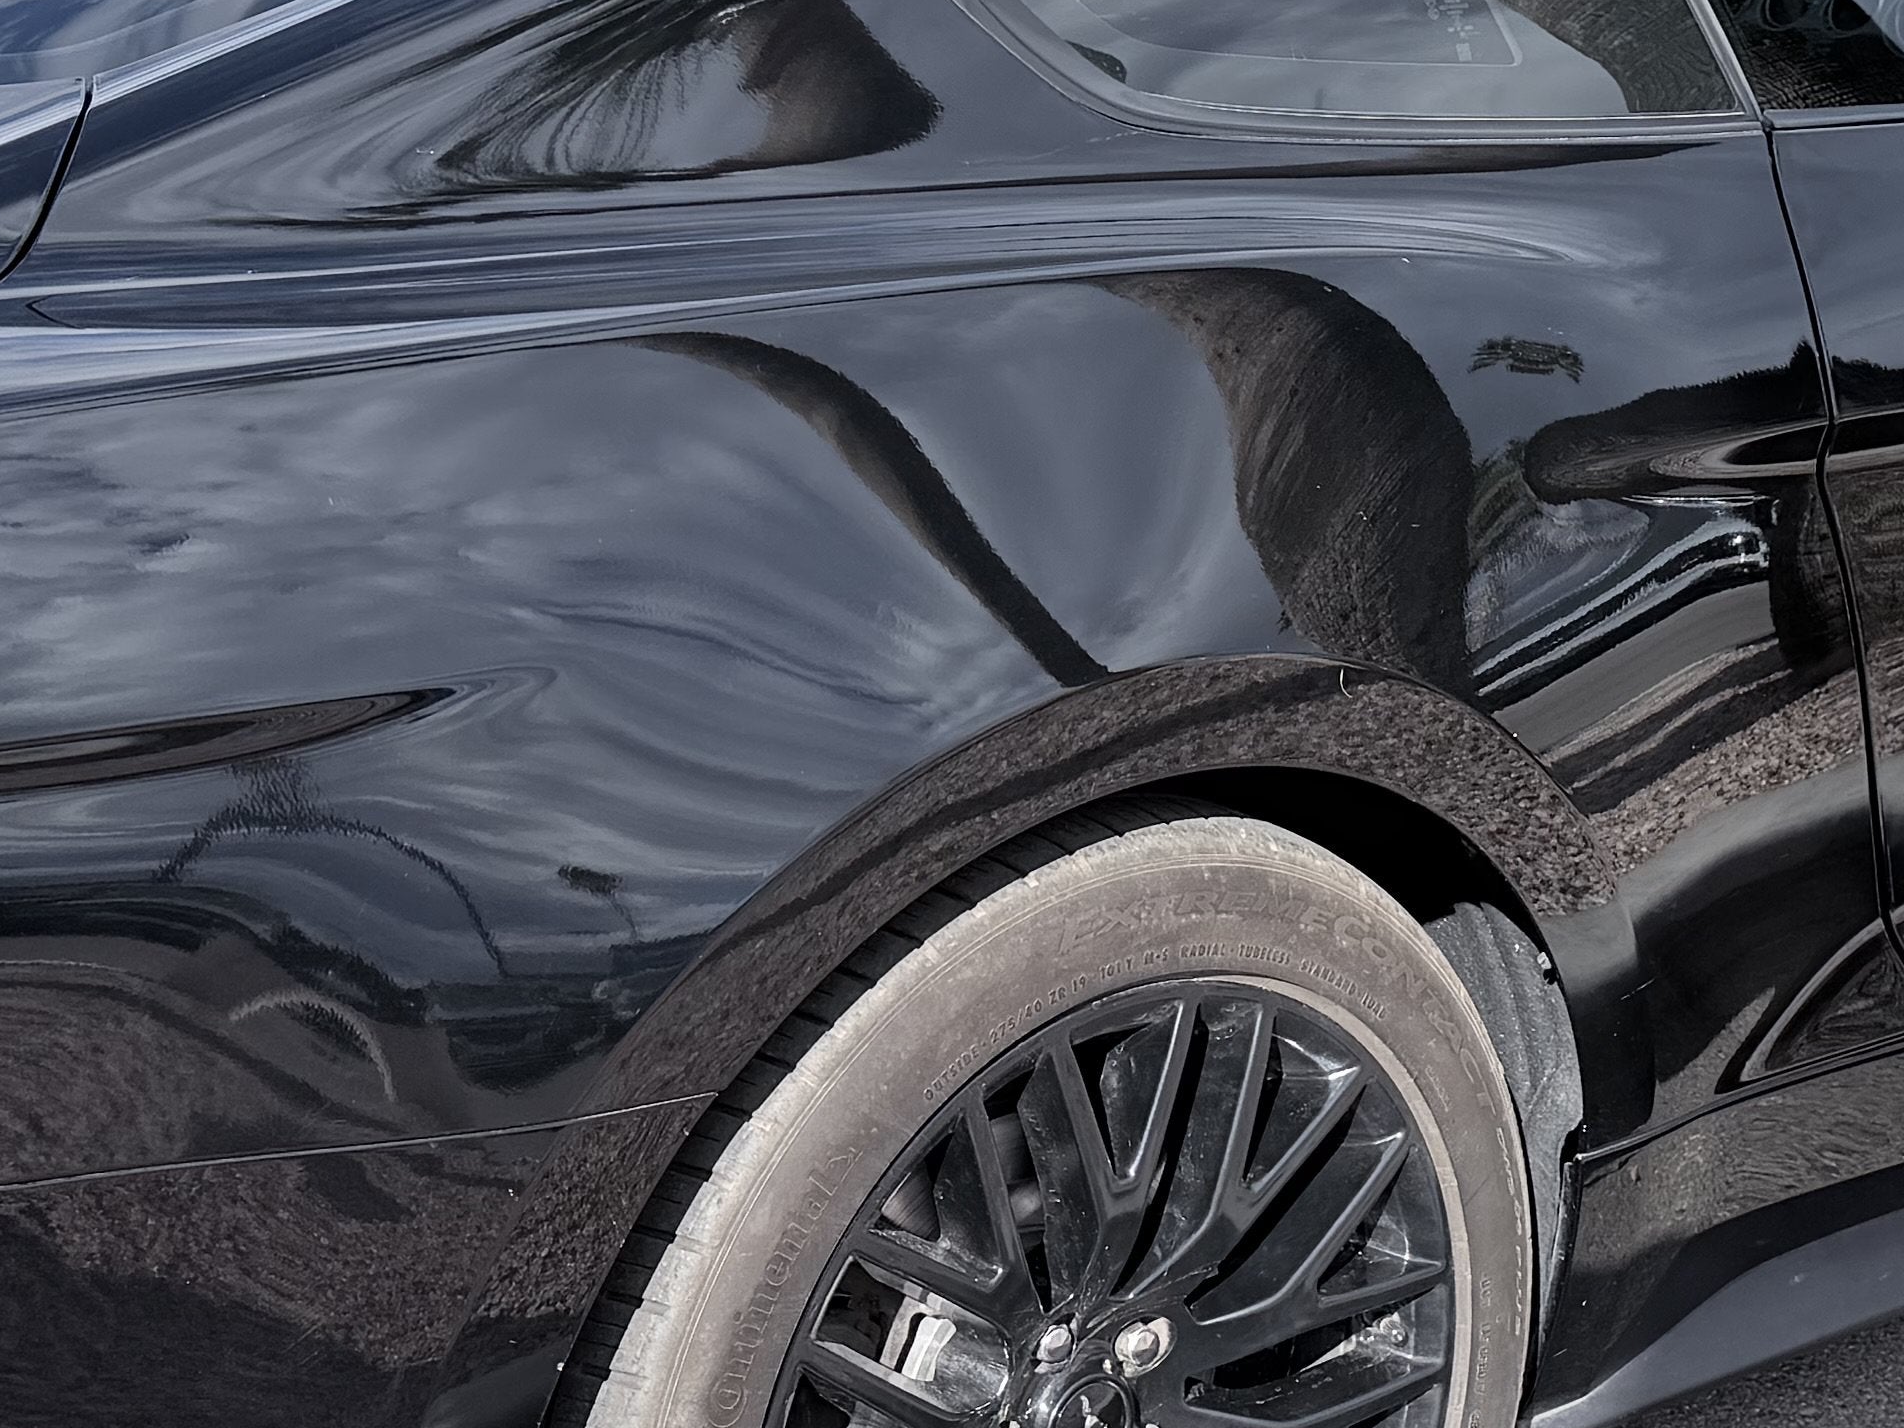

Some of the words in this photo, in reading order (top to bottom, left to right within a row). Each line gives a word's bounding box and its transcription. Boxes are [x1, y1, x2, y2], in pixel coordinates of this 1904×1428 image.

[922, 1043, 980, 1103] OUTSIDE
[987, 997, 1044, 1045] 275/40
[1047, 983, 1066, 1006] ZR
[1071, 973, 1088, 994] 19
[1179, 942, 1227, 959] RADIAL
